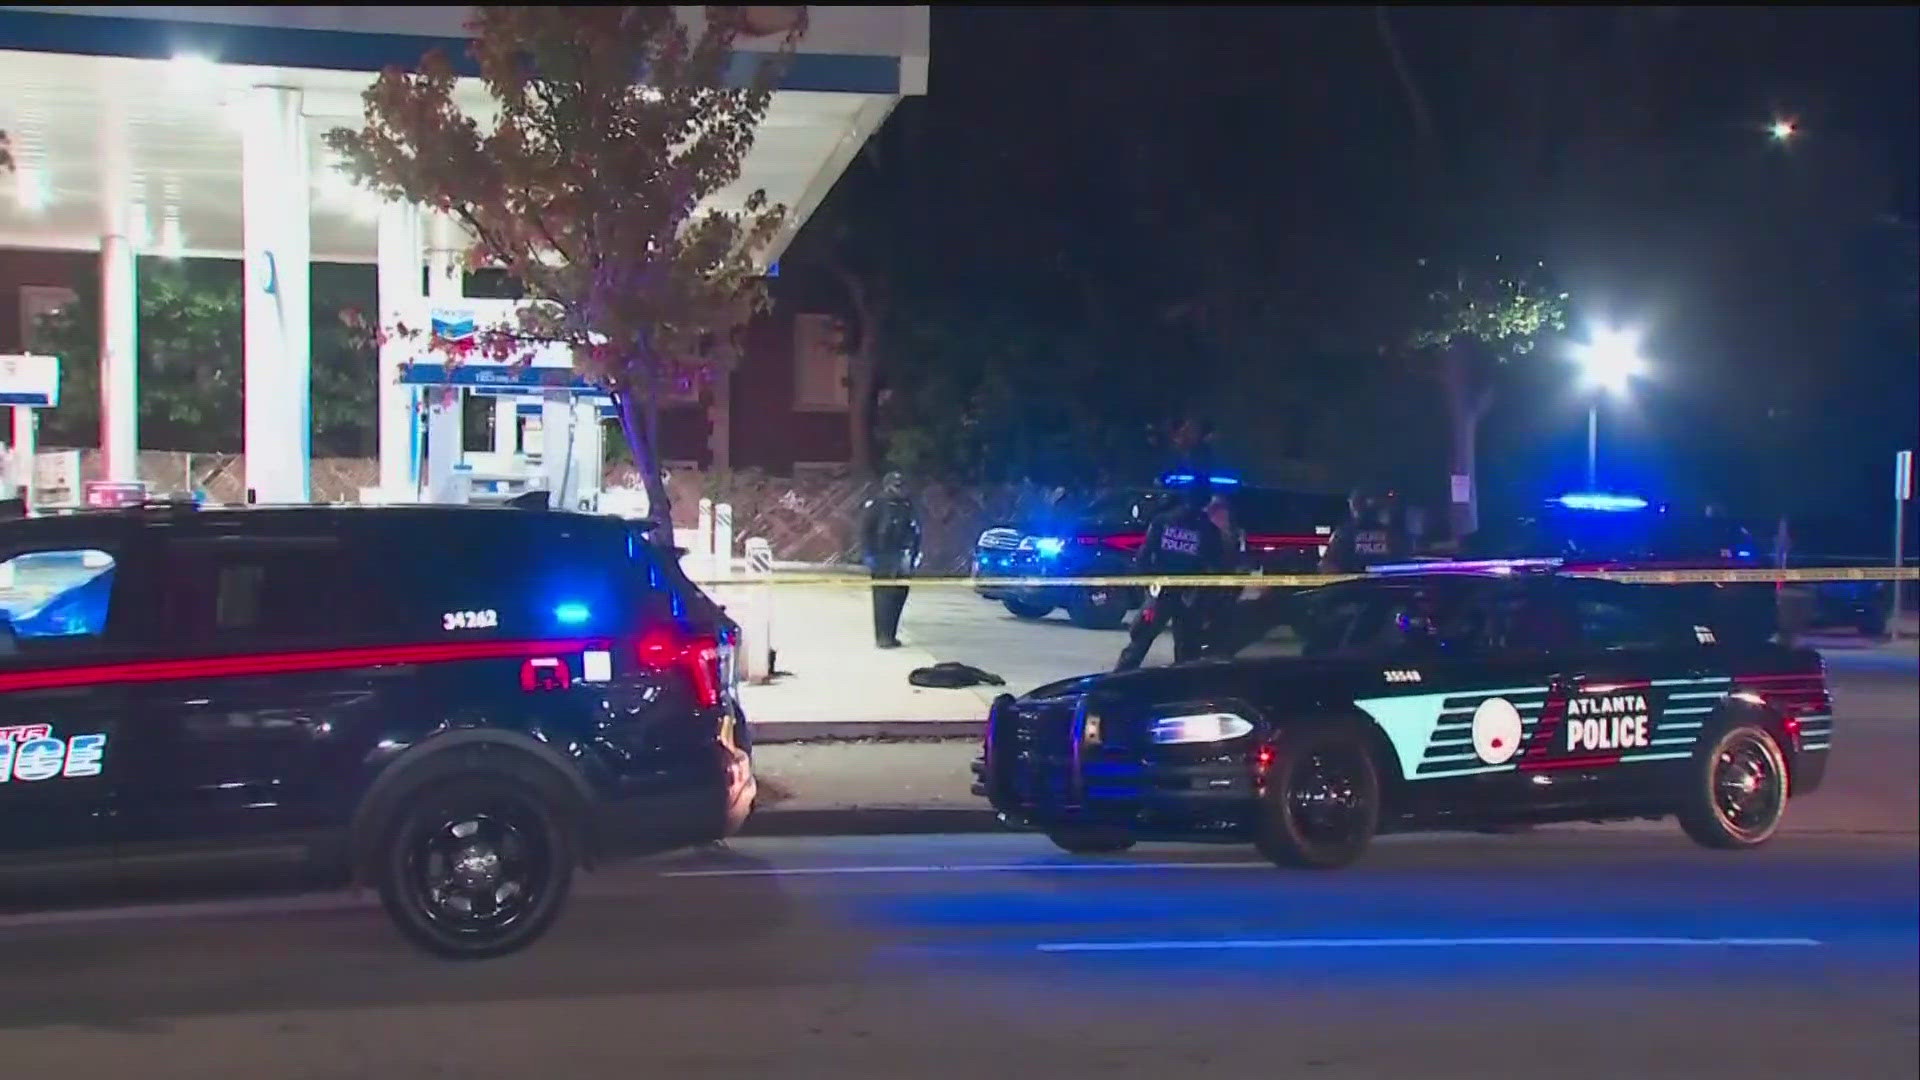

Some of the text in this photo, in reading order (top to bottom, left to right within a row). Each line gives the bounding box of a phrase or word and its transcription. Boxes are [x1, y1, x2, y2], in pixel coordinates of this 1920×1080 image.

[1161, 539, 1198, 554] POLICE
[443, 609, 498, 631] 34262
[1568, 696, 1647, 715] ATLANTA
[1567, 716, 1648, 752] POLICE
